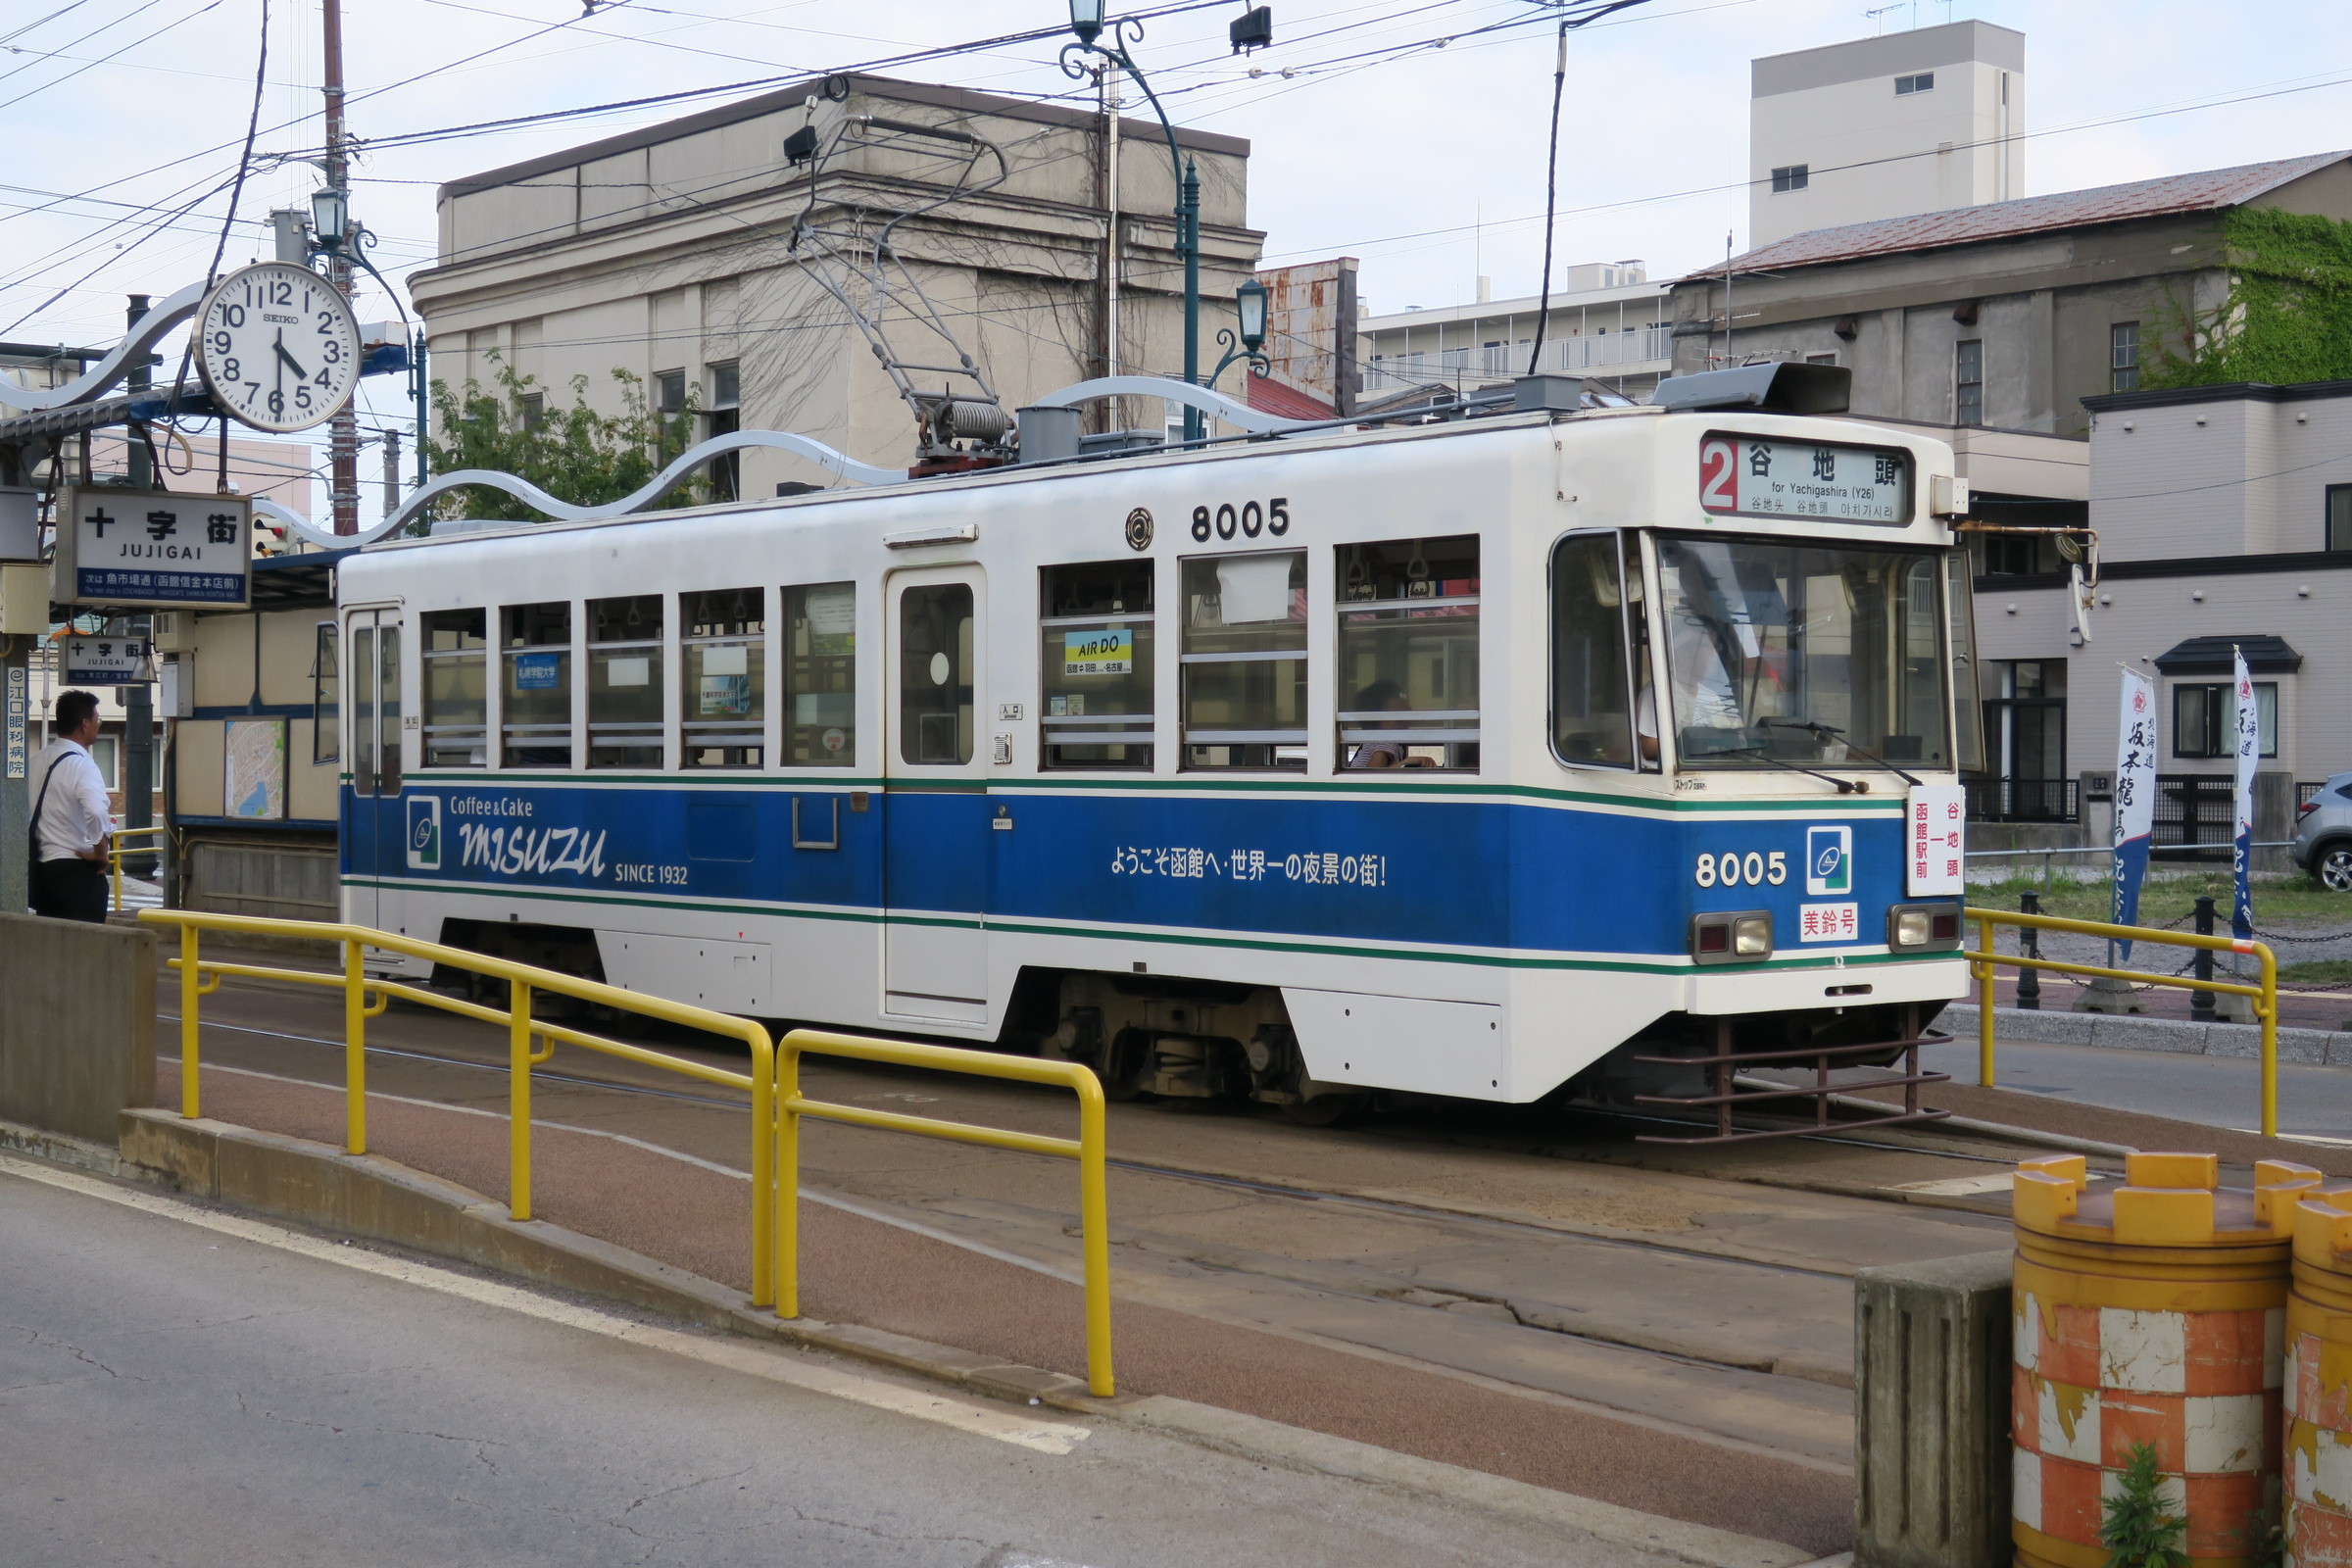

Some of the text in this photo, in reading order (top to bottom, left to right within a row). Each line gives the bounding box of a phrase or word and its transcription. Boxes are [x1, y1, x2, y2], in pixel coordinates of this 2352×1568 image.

[246, 284, 264, 310] 11
[270, 280, 293, 307] 12
[304, 290, 310, 314] 1
[222, 303, 245, 328] 10
[263, 314, 299, 324] SEIKO
[317, 311, 333, 335] 2
[214, 330, 232, 356] 9
[322, 340, 340, 365] 3
[222, 358, 241, 382] 8
[314, 367, 331, 390] 4
[244, 381, 261, 405] 7
[268, 389, 285, 415] 6
[294, 385, 312, 409] 5
[1701, 441, 1734, 508] 2
[1749, 443, 1896, 486] 谷地頭
[1772, 481, 1875, 500] for Yachigashira (Y26)
[1751, 496, 1829, 515] 谷地头 谷地頭
[1840, 503, 1893, 519] 야치가시라
[84, 507, 237, 545] 十字街
[1191, 498, 1290, 543] 8005
[120, 544, 201, 560] JUJIGAI
[85, 574, 103, 584] 次は
[72, 642, 139, 658] 十字街
[1078, 635, 1119, 657] AIR DO
[9, 686, 24, 774] 江口眼科病院
[459, 823, 607, 877] MISUZU
[1916, 803, 1928, 879] 函館駅前
[1946, 802, 1959, 877] 谷地頭
[614, 863, 688, 885] SINCE 1932
[1695, 852, 1787, 888] 8005
[1803, 908, 1855, 936] 美鈴号
